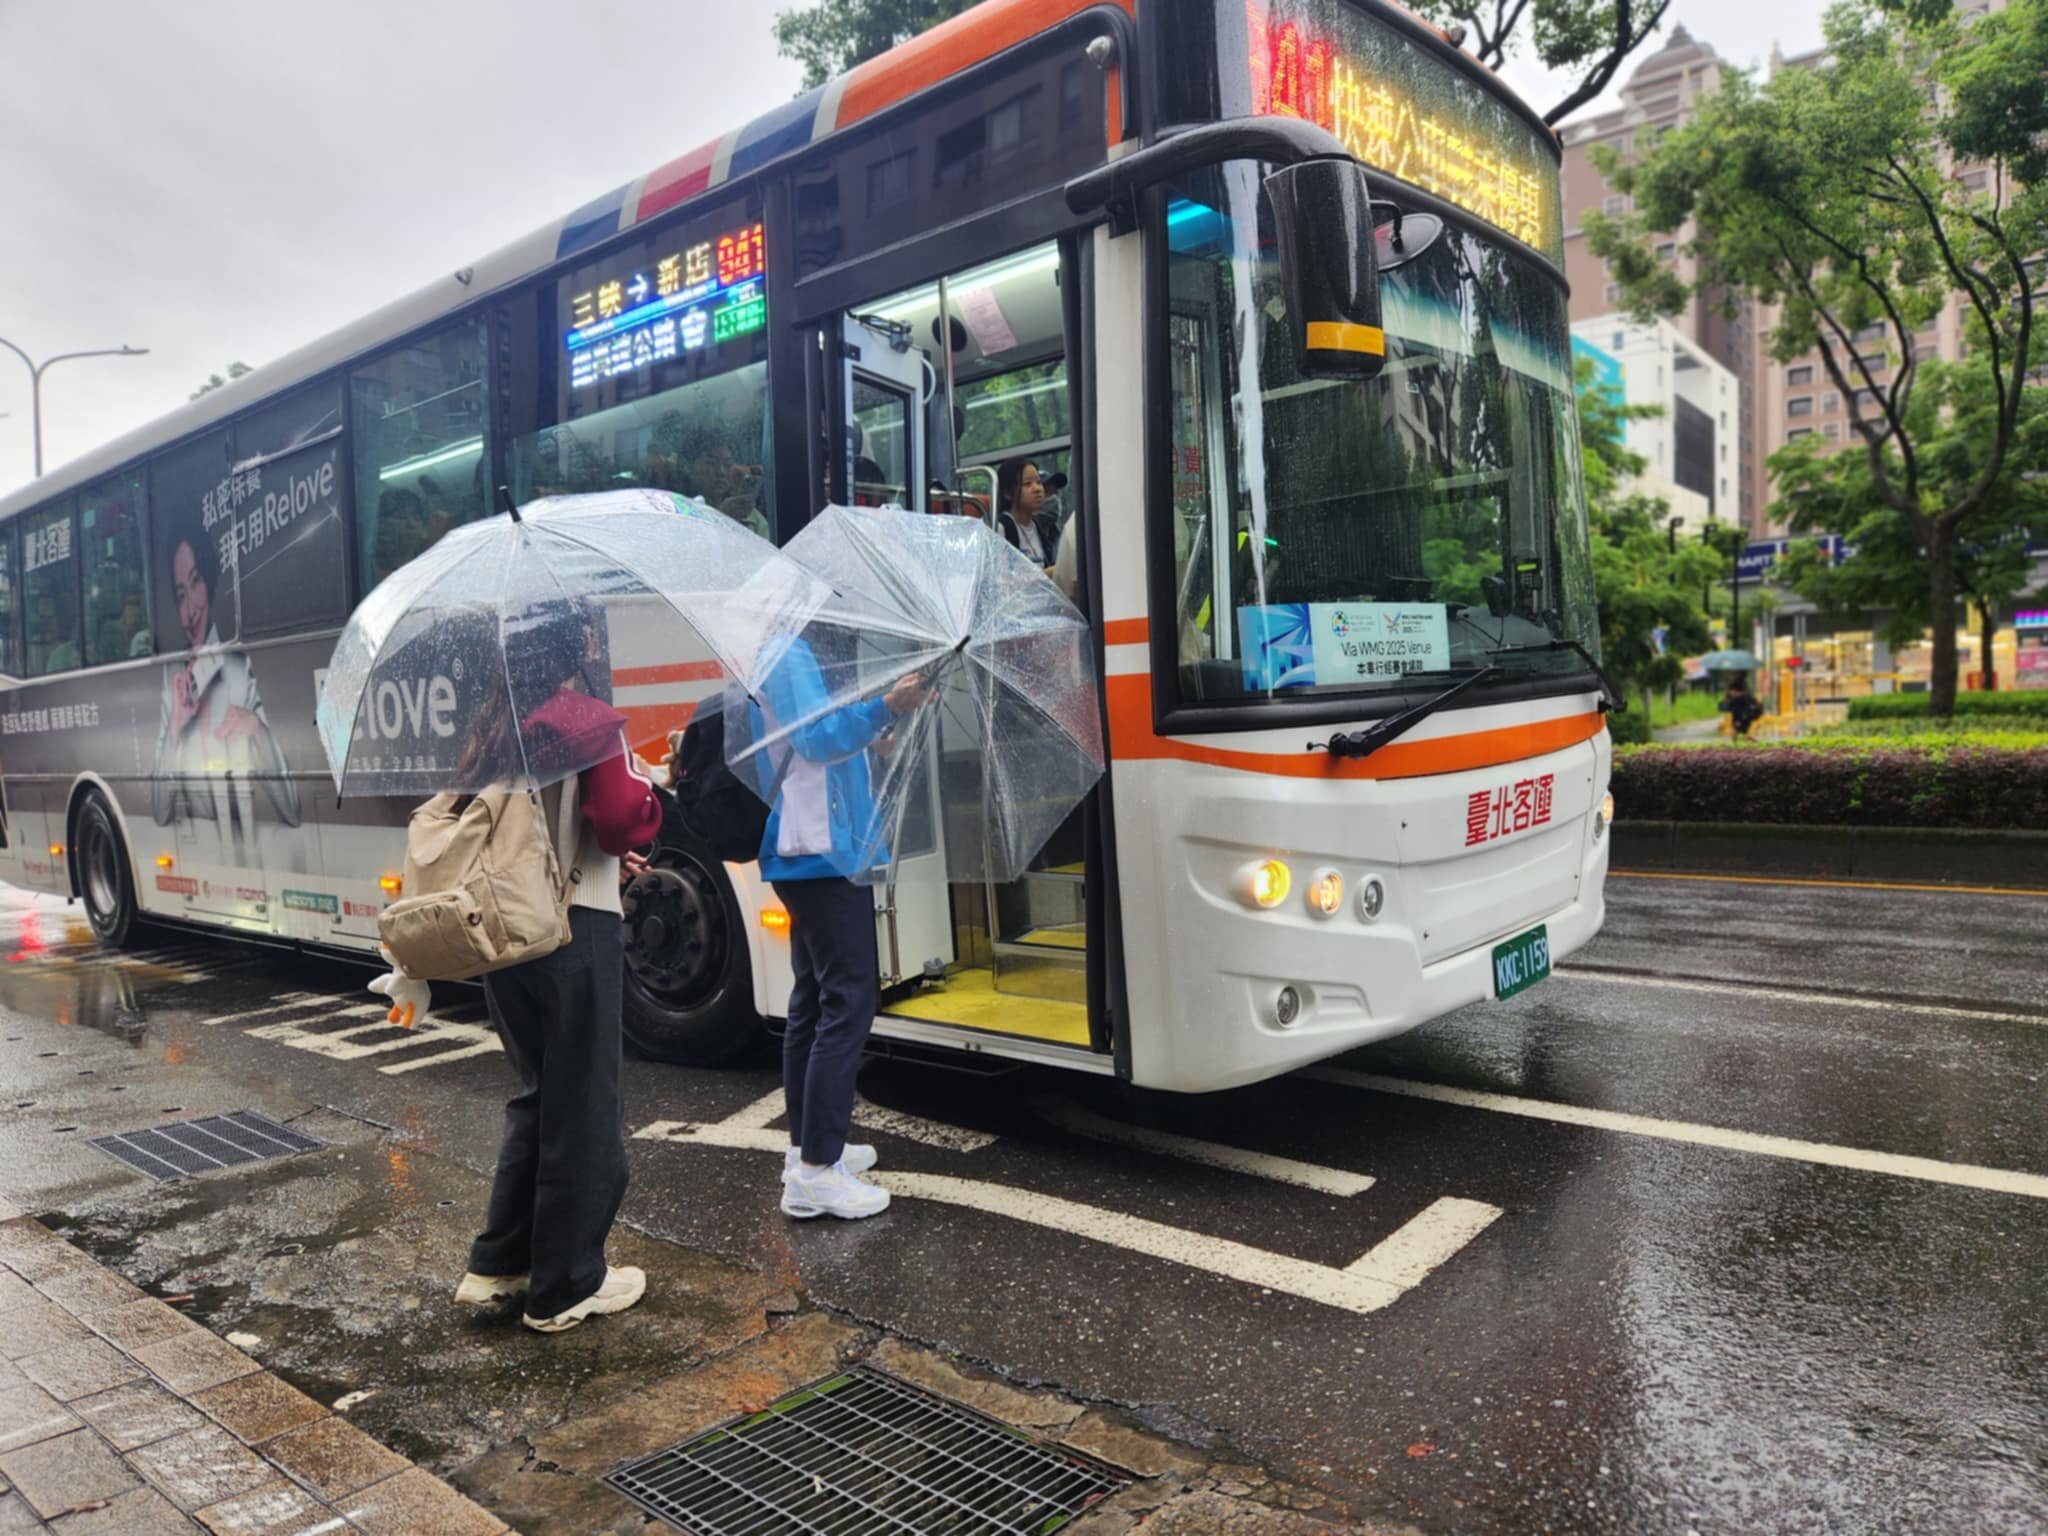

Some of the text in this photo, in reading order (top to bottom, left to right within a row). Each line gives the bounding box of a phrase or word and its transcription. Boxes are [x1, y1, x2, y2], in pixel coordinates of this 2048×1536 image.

[657, 242, 711, 296] 新店
[717, 223, 763, 285] 941
[1341, 640, 1432, 657] Via WMG 2025 Venue
[1465, 773, 1555, 847] 臺北客運
